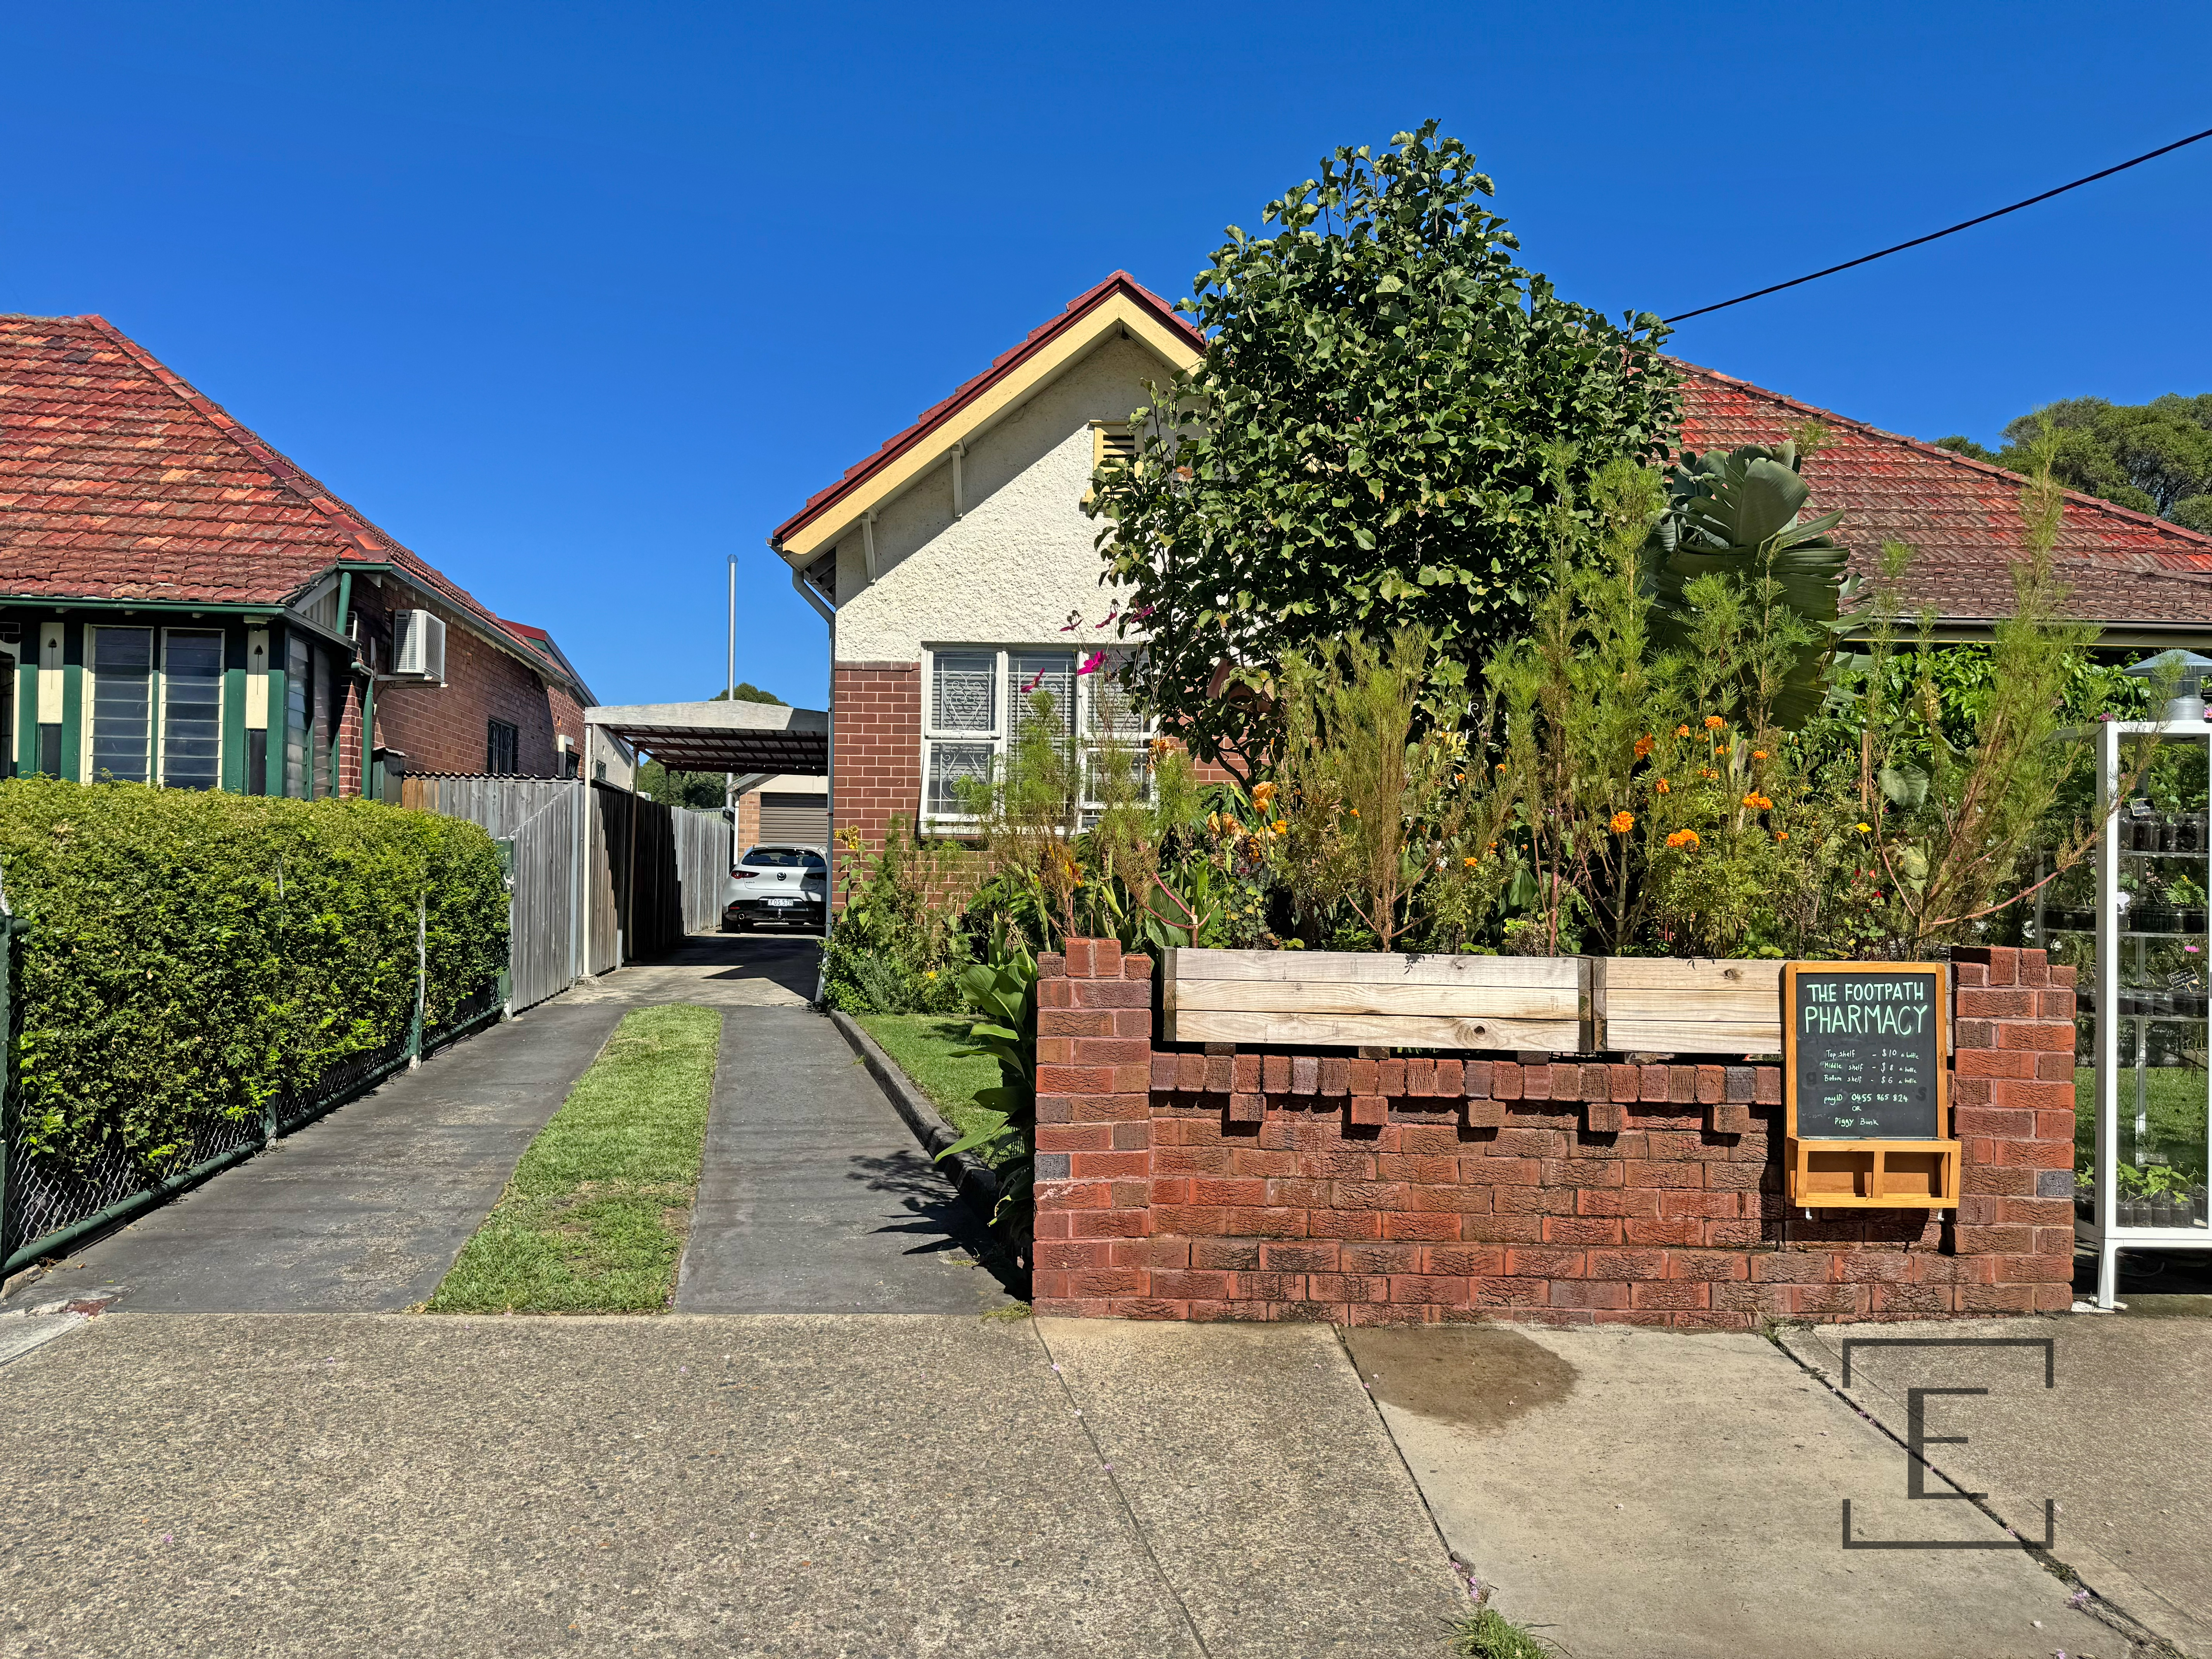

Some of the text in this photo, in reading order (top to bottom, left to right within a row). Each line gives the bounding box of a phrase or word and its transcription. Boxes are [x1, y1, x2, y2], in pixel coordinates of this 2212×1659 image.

[1806, 982, 1923, 1003] THE FOOTPATH
[1805, 1004, 1928, 1036] PHARMACY
[1826, 1049, 1836, 1060] Top
[1839, 1049, 1855, 1058] shelf
[1848, 1063, 1863, 1072] shelf
[1847, 1075, 1862, 1084] shelf
[1824, 1093, 1908, 1105] payID 0455 865 824
[1834, 1117, 1854, 1128] Piggy
